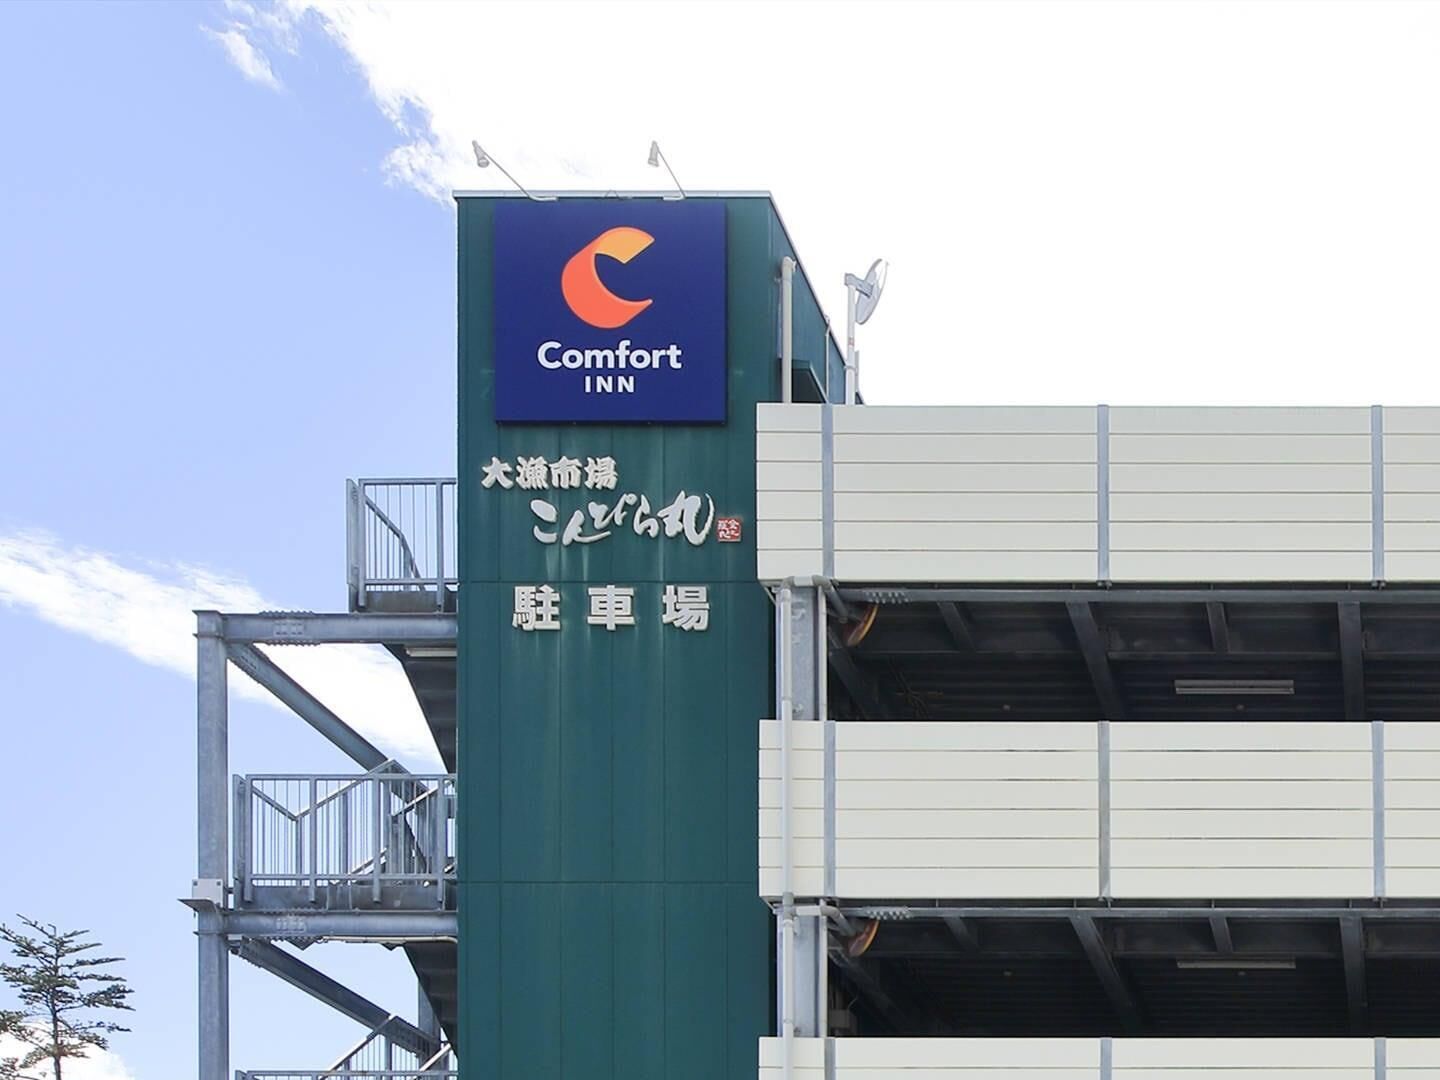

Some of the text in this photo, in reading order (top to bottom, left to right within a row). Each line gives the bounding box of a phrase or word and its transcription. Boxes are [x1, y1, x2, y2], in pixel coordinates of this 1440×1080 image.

[537, 341, 682, 369] Comfort
[585, 376, 635, 393] INN
[481, 456, 618, 489] 大漁市場
[512, 585, 710, 631] 駐車場
